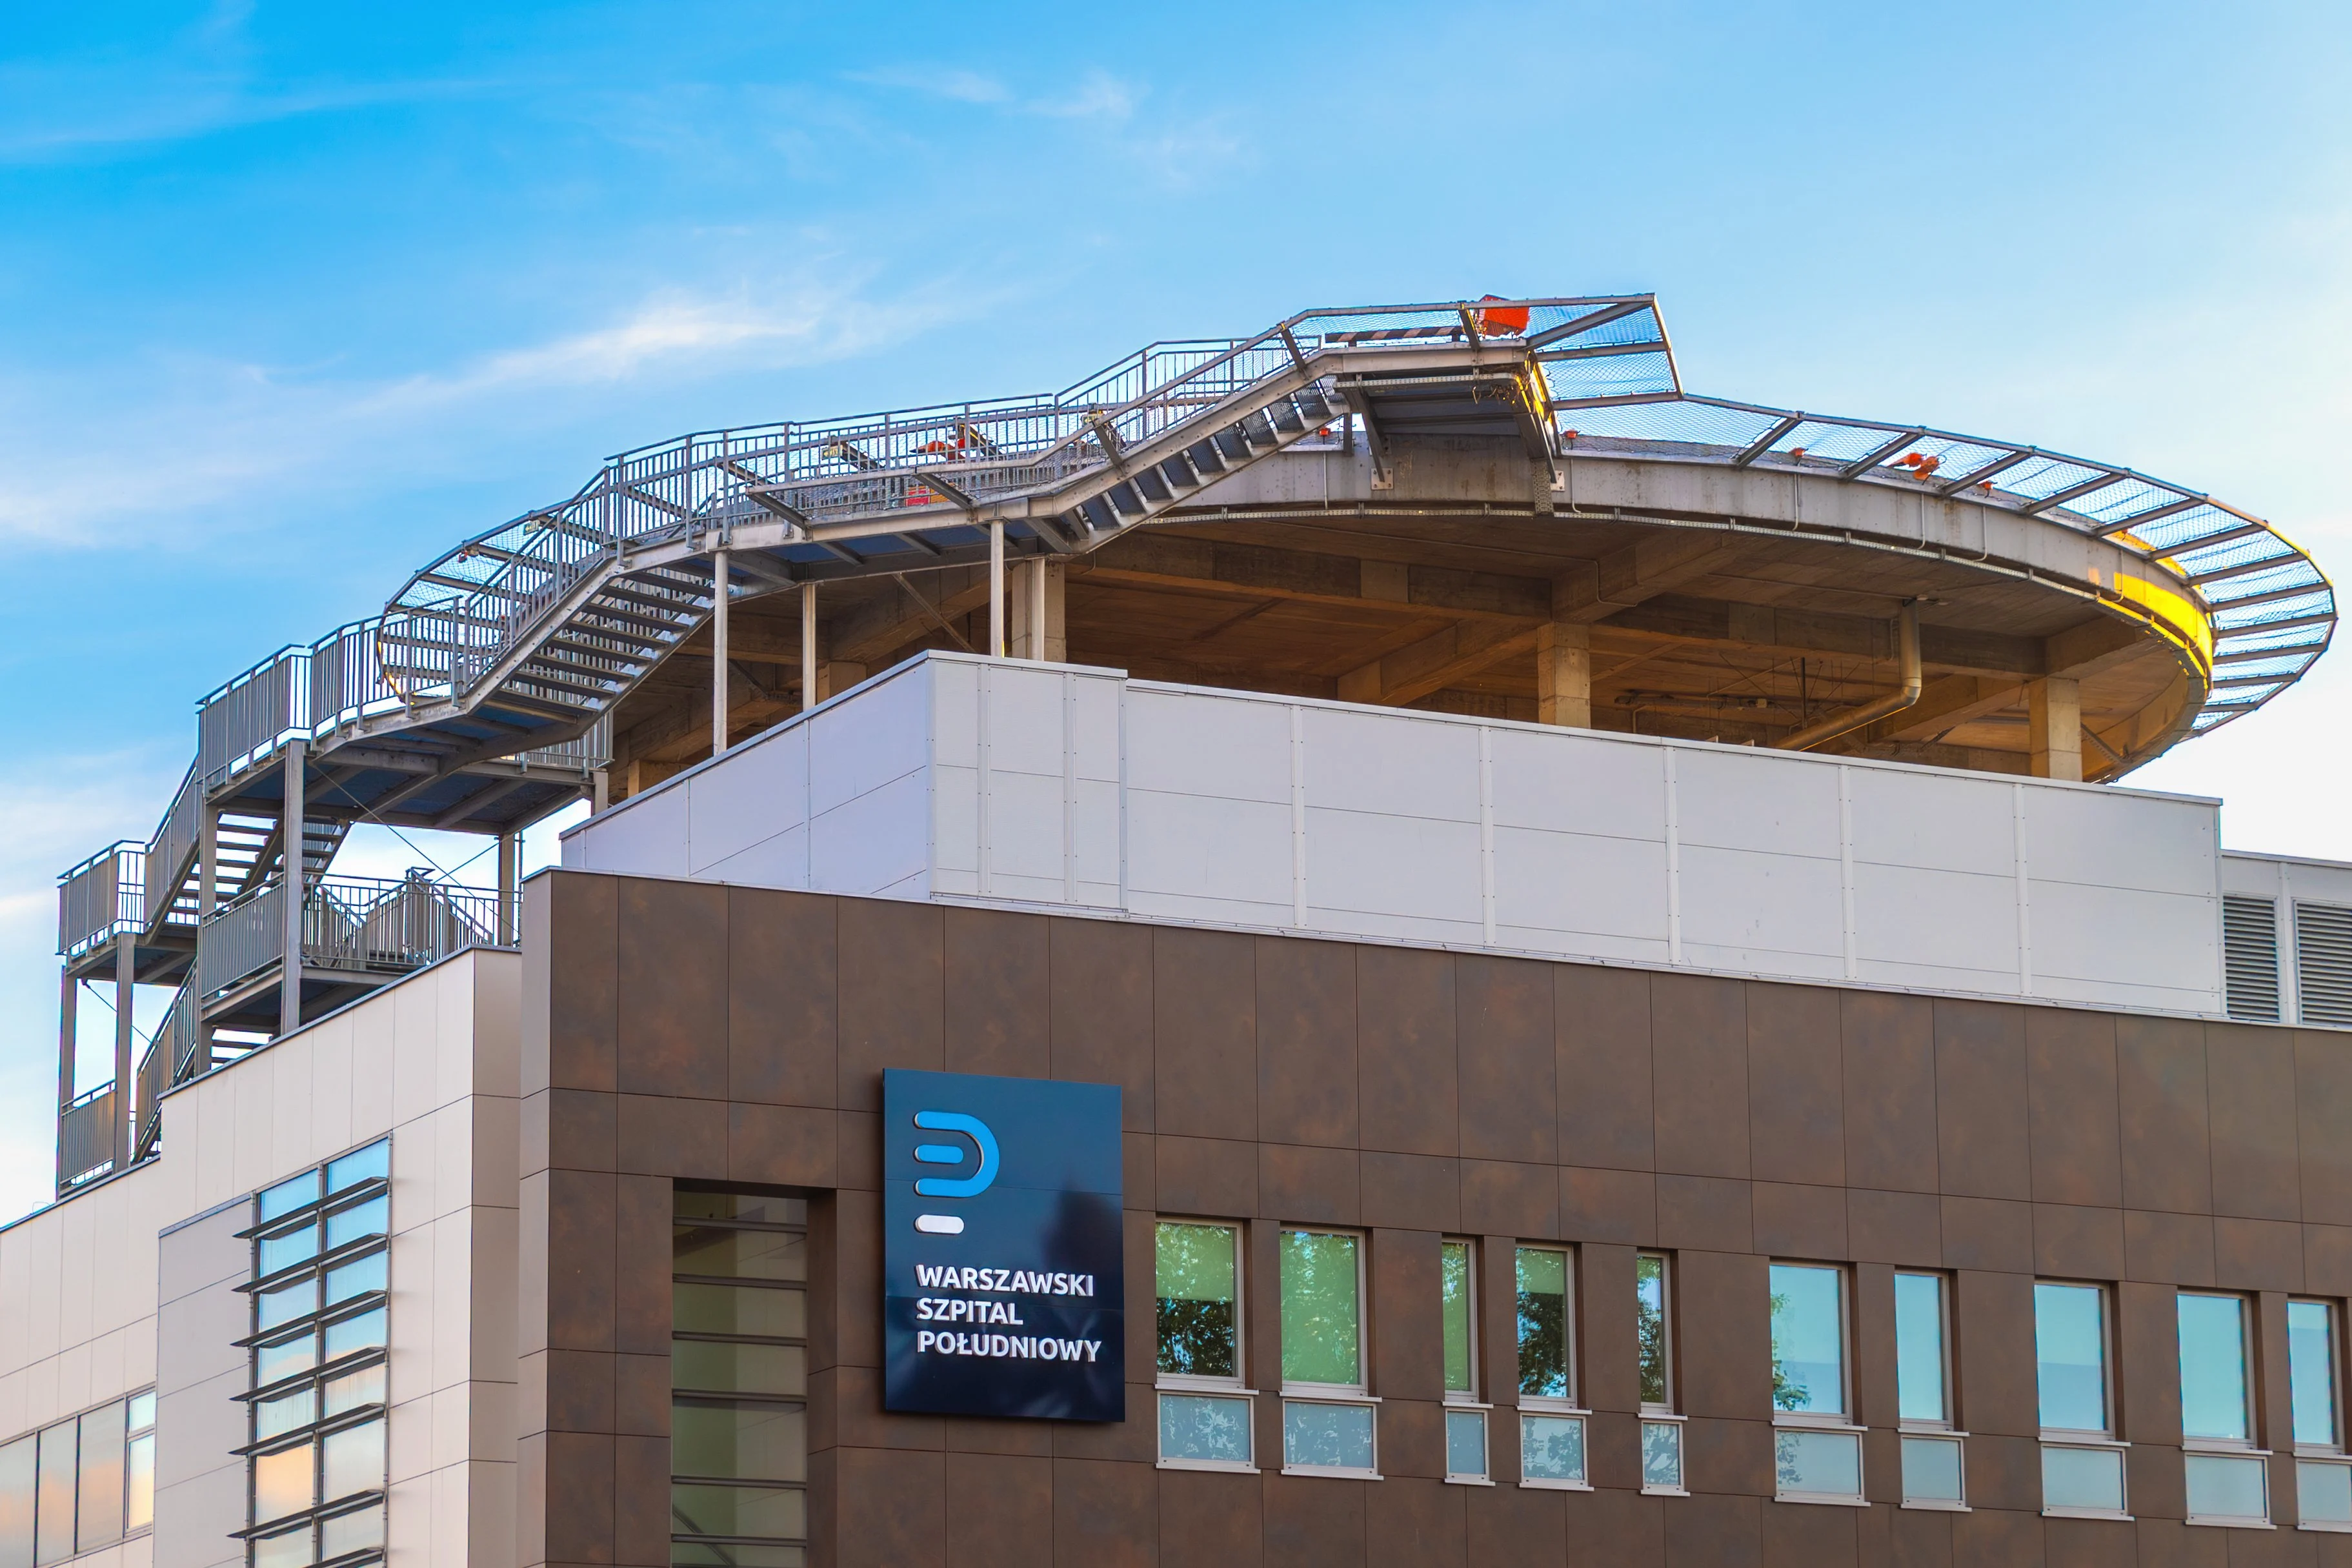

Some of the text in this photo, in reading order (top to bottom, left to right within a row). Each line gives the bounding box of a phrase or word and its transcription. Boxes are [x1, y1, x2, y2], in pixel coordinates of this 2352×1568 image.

[915, 1264, 1094, 1296] WARSZAWSKI
[916, 1298, 1023, 1325] SZPITAL
[917, 1331, 1101, 1362] POŁUDNIOWY
